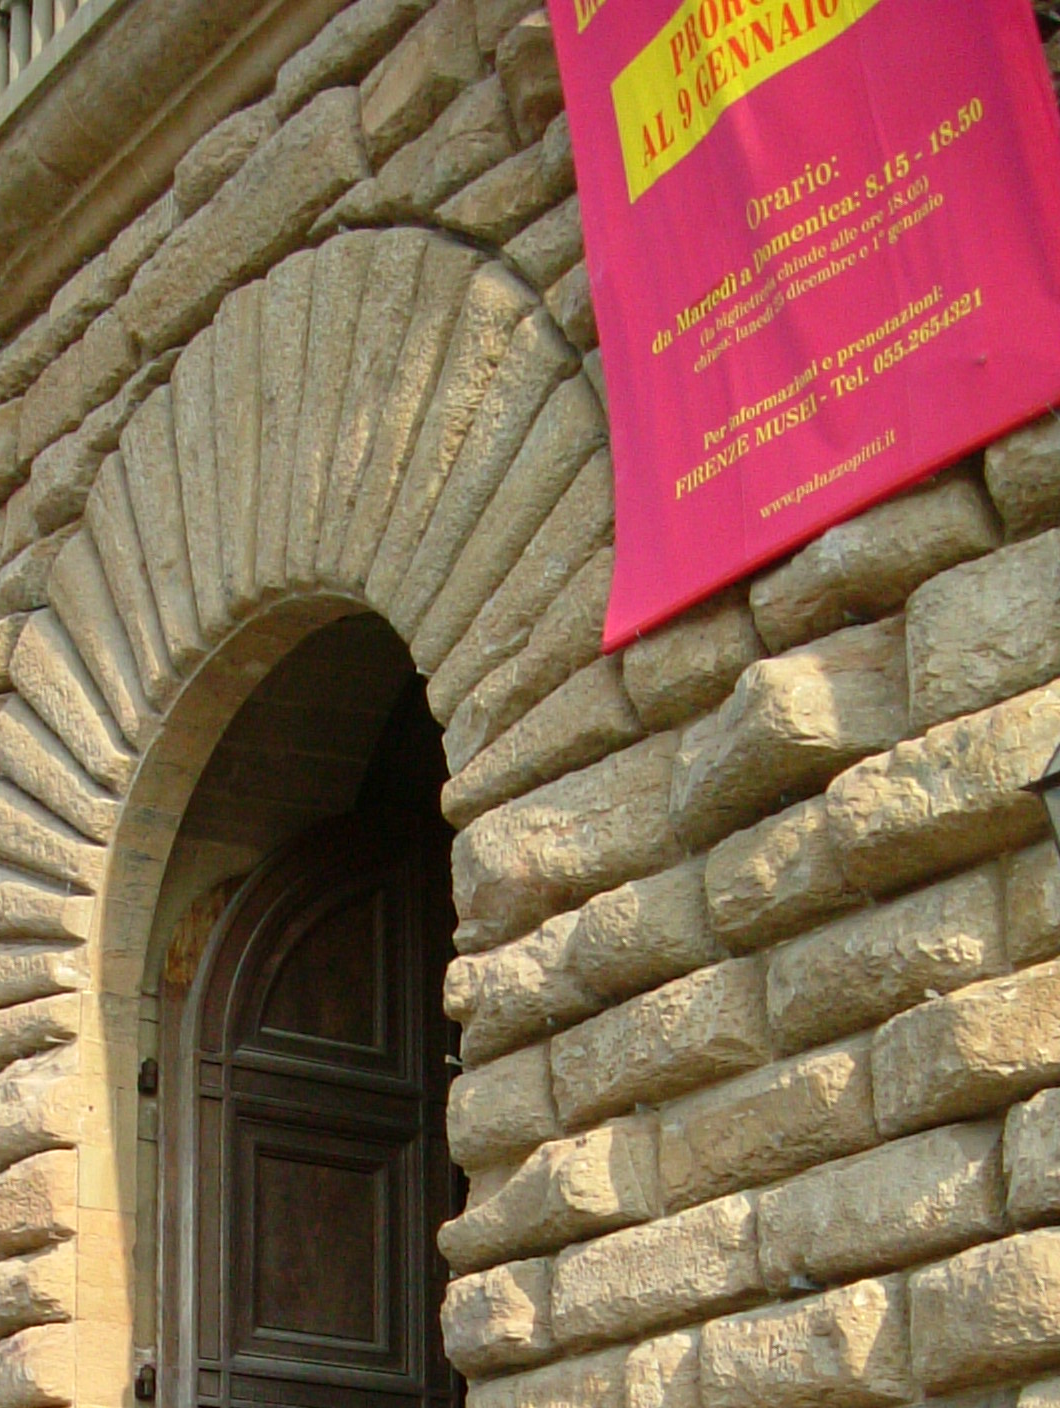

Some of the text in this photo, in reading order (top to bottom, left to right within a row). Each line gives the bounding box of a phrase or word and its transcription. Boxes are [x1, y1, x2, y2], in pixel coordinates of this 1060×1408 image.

[641, 111, 675, 168] AL
[677, 88, 692, 130] 9
[651, 331, 673, 354] da
[675, 273, 737, 335] Martedì
[740, 267, 752, 287] a
[752, 191, 860, 275] Domenica:
[865, 153, 909, 199] 8.15
[929, 97, 983, 154] 18.50
[745, 155, 840, 230] Orario:
[887, 193, 944, 245] gennaio
[777, 242, 826, 283] chiude
[830, 228, 858, 253] alle
[861, 211, 883, 233] ore
[703, 424, 727, 450] Per
[822, 358, 833, 370] e
[838, 285, 944, 367] prenotazioni:
[675, 434, 749, 499] FIRENZE
[755, 393, 818, 446] MUSEI
[830, 366, 870, 398] Tel.
[760, 429, 896, 518] www.palazzopitti.it
